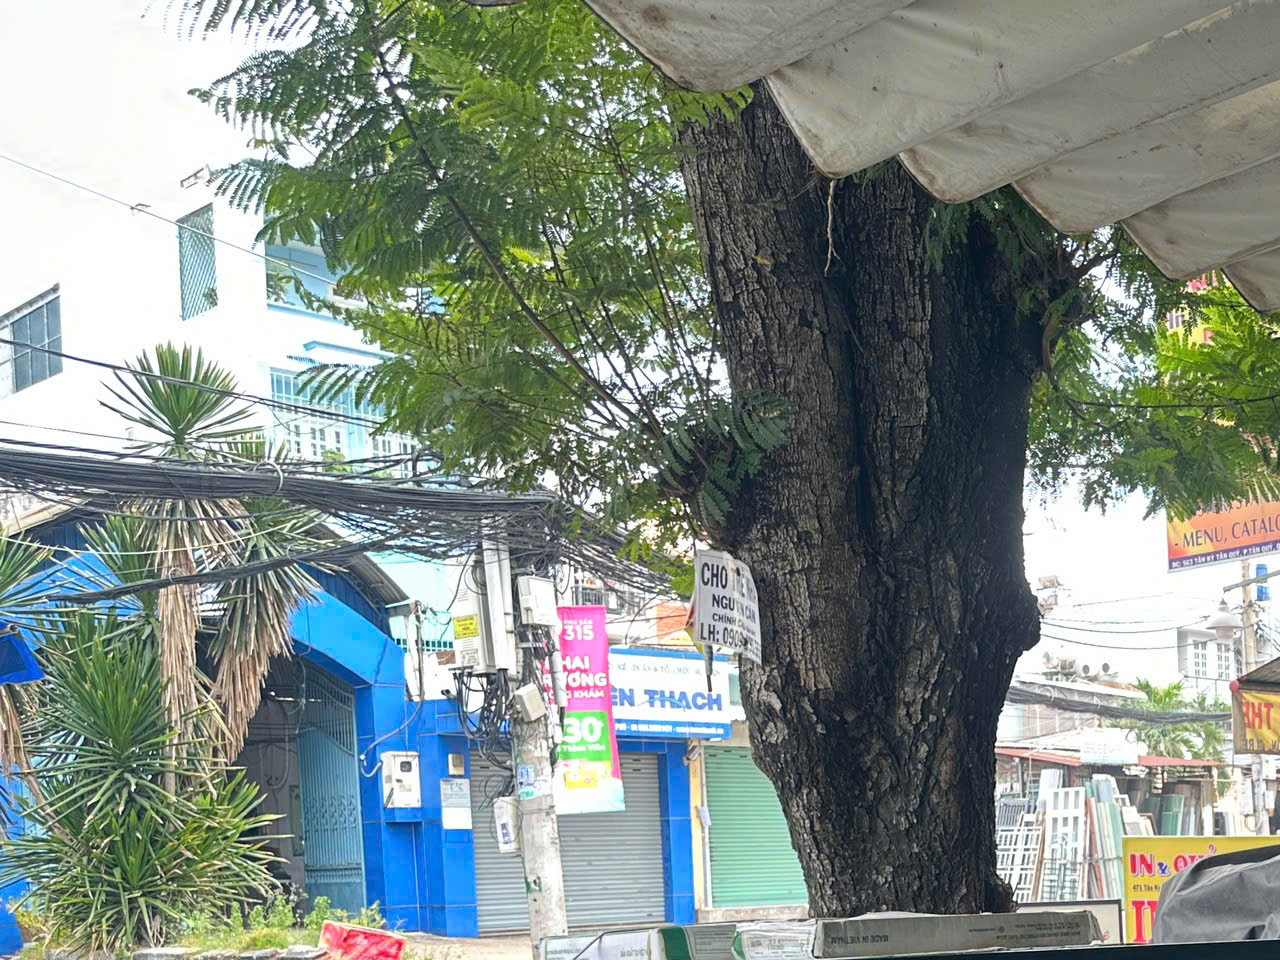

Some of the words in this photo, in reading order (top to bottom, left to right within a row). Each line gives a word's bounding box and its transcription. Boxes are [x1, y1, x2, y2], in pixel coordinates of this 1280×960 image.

[1183, 527, 1227, 548] MENU,
[701, 562, 728, 589] CHO
[563, 625, 594, 641] 315
[700, 623, 719, 643] LH:
[1129, 853, 1155, 877] IN
